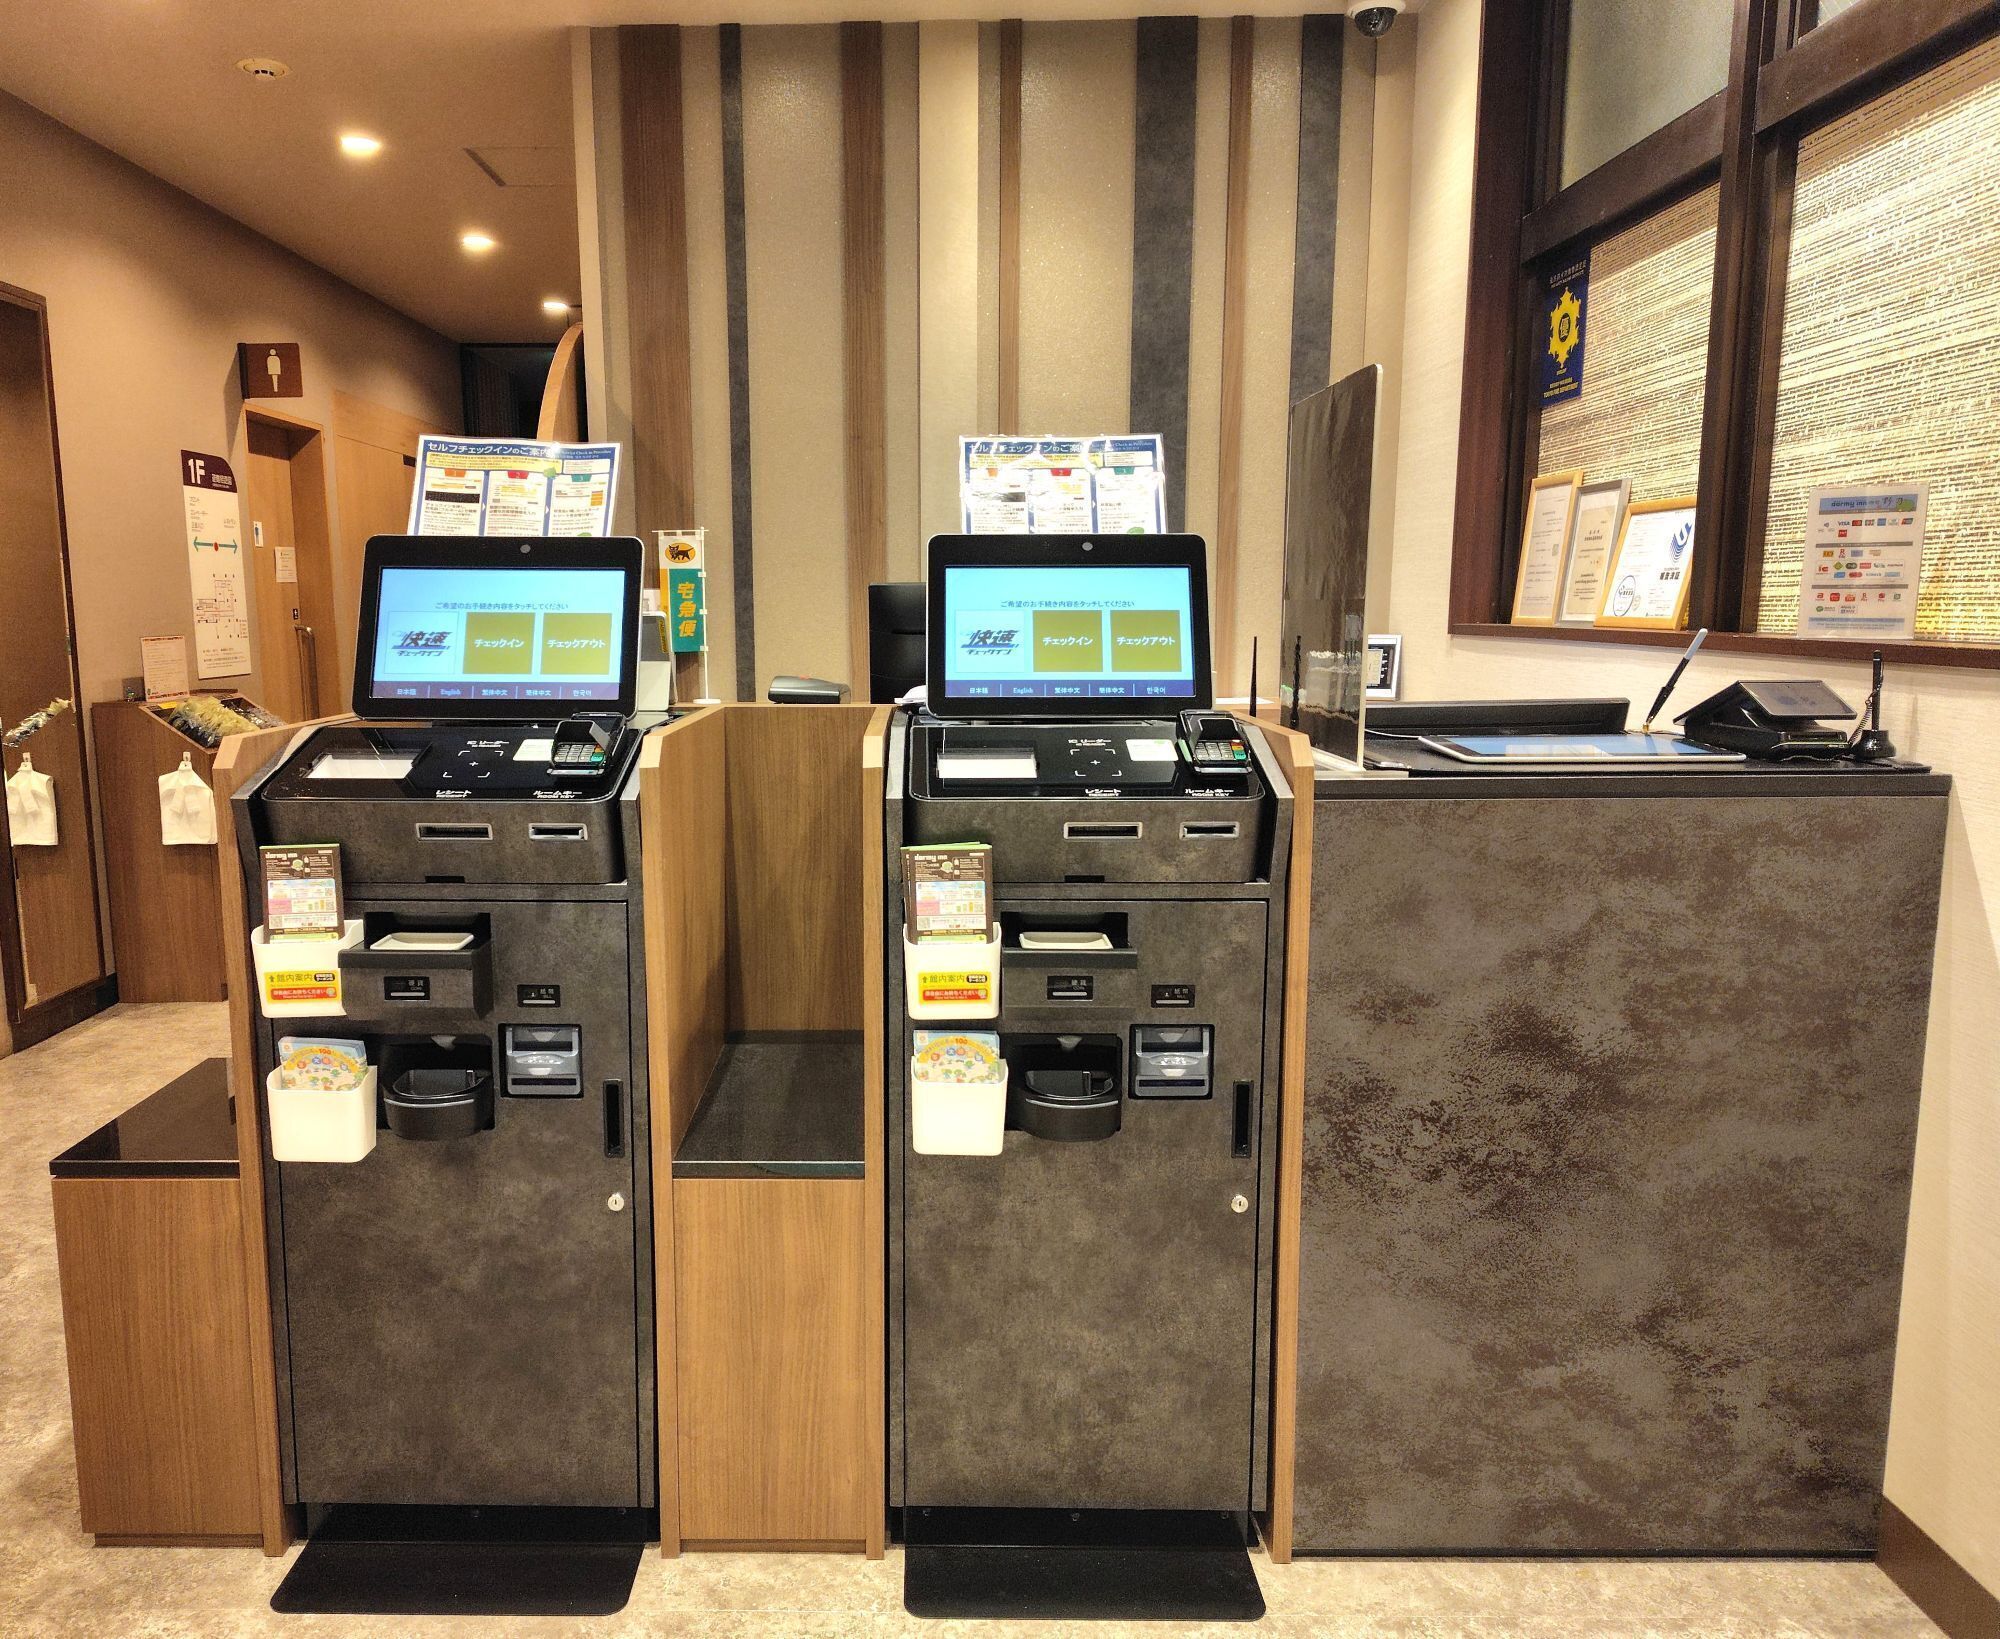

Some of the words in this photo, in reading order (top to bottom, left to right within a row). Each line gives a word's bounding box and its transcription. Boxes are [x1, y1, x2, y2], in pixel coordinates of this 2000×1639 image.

[188, 459, 205, 484] 1F
[435, 602, 569, 611] ご希望のお手続き内容をタッチしてください
[1001, 600, 1135, 608] ご希望のお手続き内容をタッチしてください
[677, 582, 697, 638] 宅急便
[400, 631, 452, 647] 快速
[969, 630, 1019, 645] 快速
[1043, 636, 1093, 646] チェックイン
[1116, 636, 1176, 646] チェックアウト
[474, 639, 525, 648] チェックイン
[547, 639, 607, 649] チェックアウト
[397, 688, 417, 696] 日本語
[440, 688, 461, 697] English
[572, 689, 592, 697] 한국어
[969, 686, 988, 694] 日本語
[1013, 687, 1033, 695] English
[914, 853, 937, 862] dormy
[277, 973, 313, 983] 館内案内
[929, 974, 965, 983] 館内案内
